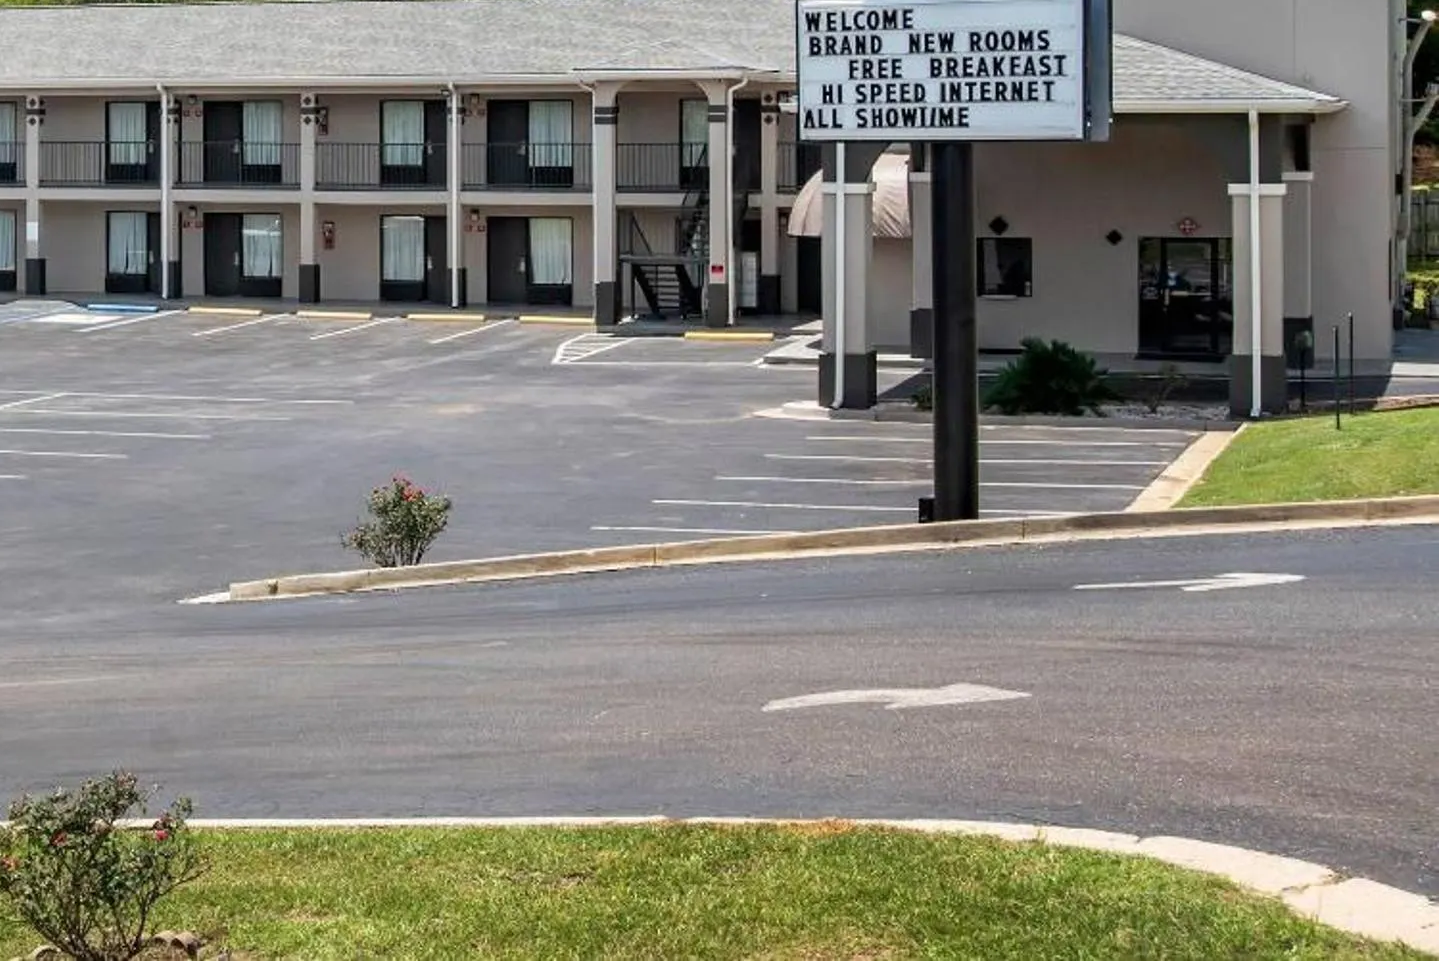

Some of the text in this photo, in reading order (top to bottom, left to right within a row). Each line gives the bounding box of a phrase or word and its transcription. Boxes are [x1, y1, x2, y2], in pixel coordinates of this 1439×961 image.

[805, 9, 914, 32] WELCOME
[808, 29, 1050, 56] BRAND NEW ROOMS
[848, 54, 1067, 80] FREE BREAKFAST
[821, 80, 1056, 105] HI SPEED INTERNET
[804, 107, 970, 129] ALL SHOWTIME
